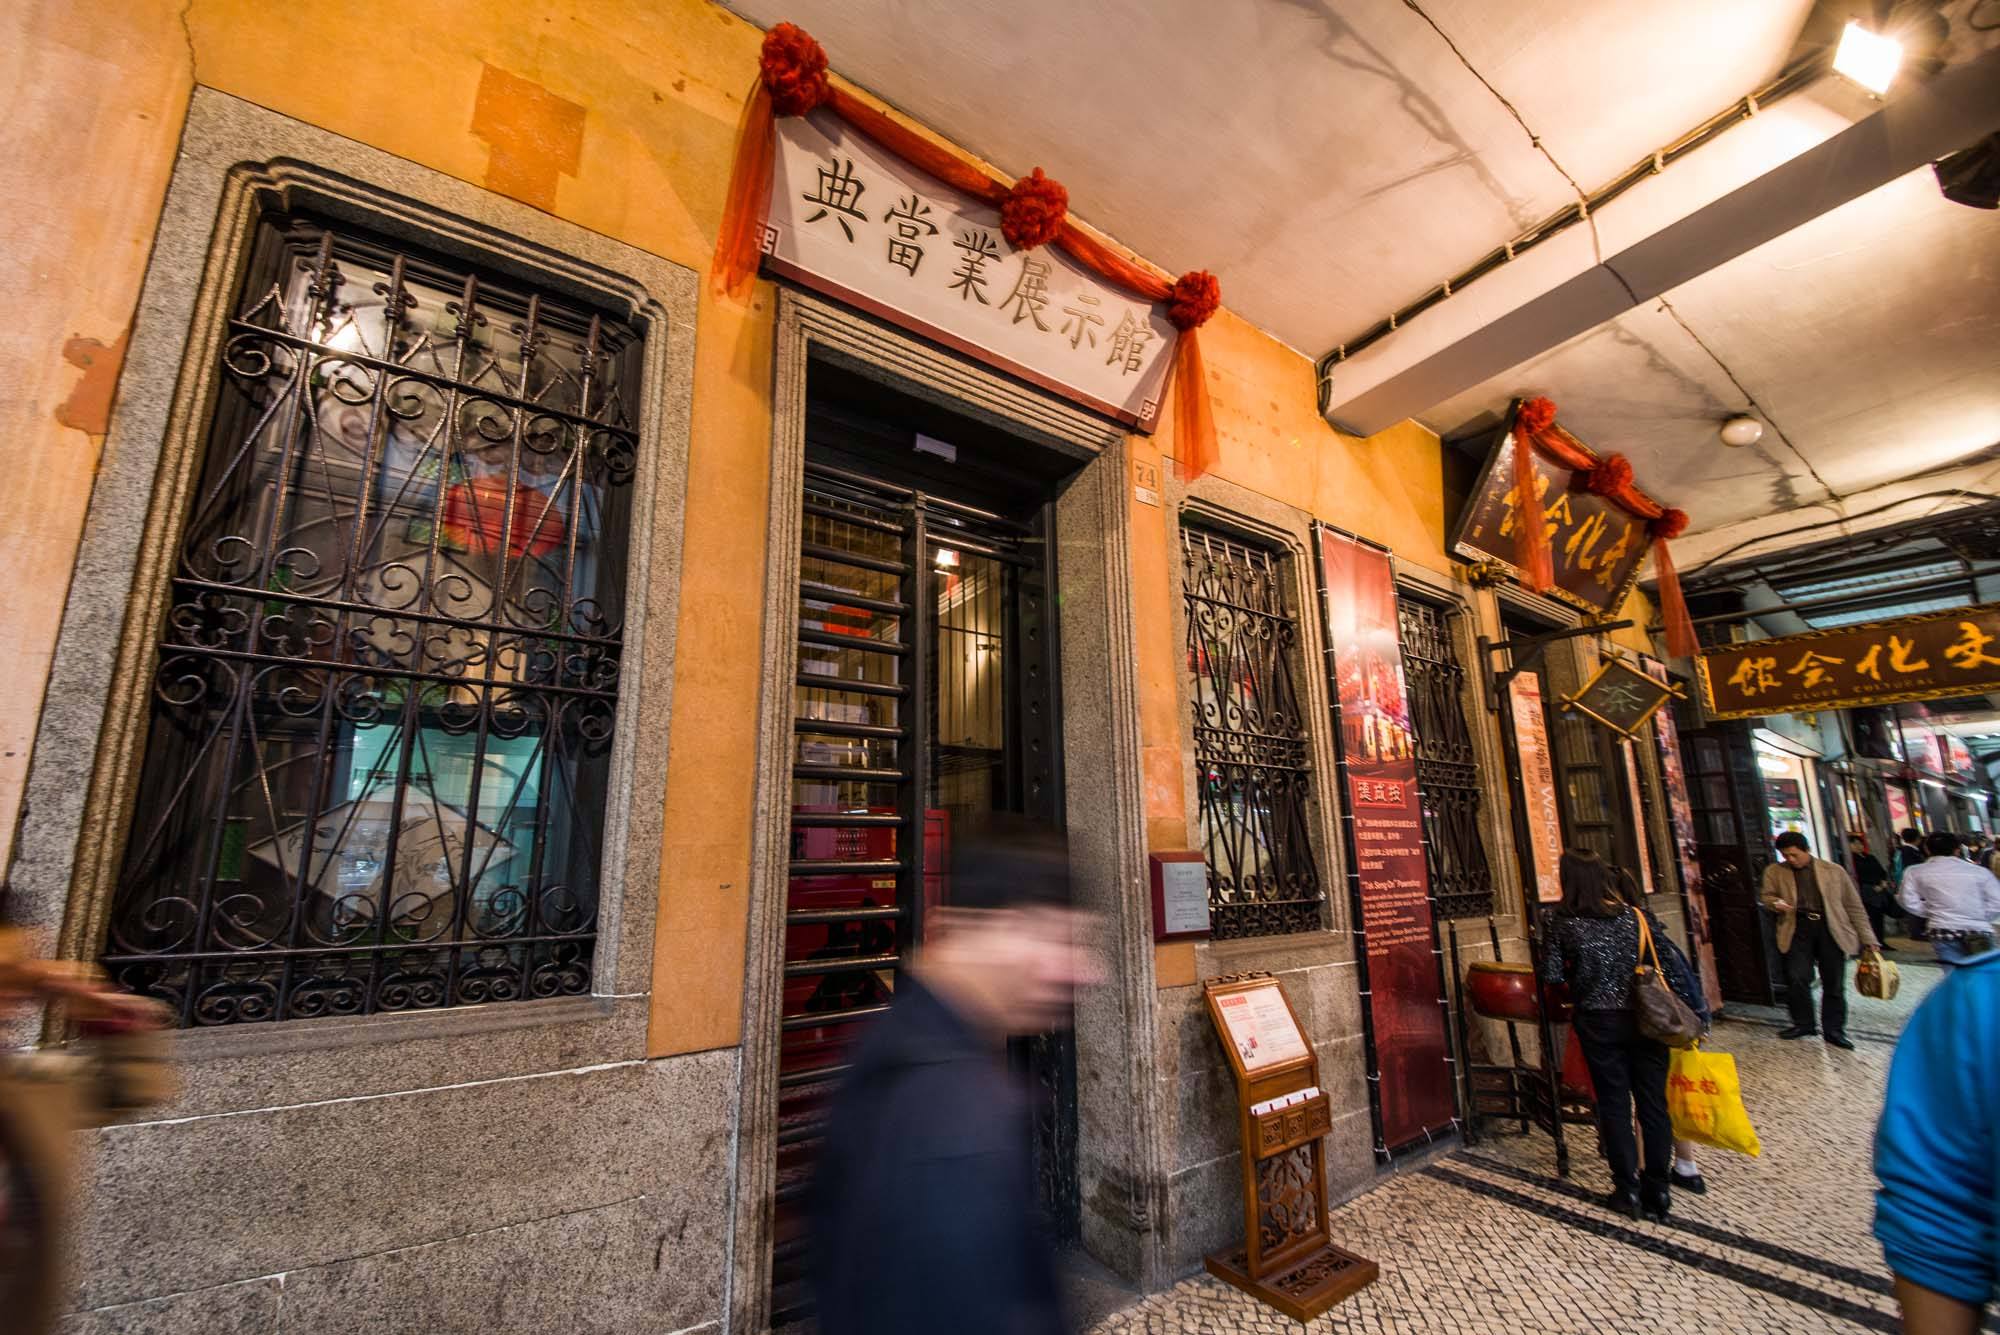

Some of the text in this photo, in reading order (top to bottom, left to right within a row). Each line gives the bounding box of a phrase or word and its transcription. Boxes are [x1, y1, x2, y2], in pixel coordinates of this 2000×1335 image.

[801, 156, 1156, 376] 典當業展示館
[1135, 465, 1156, 488] 74
